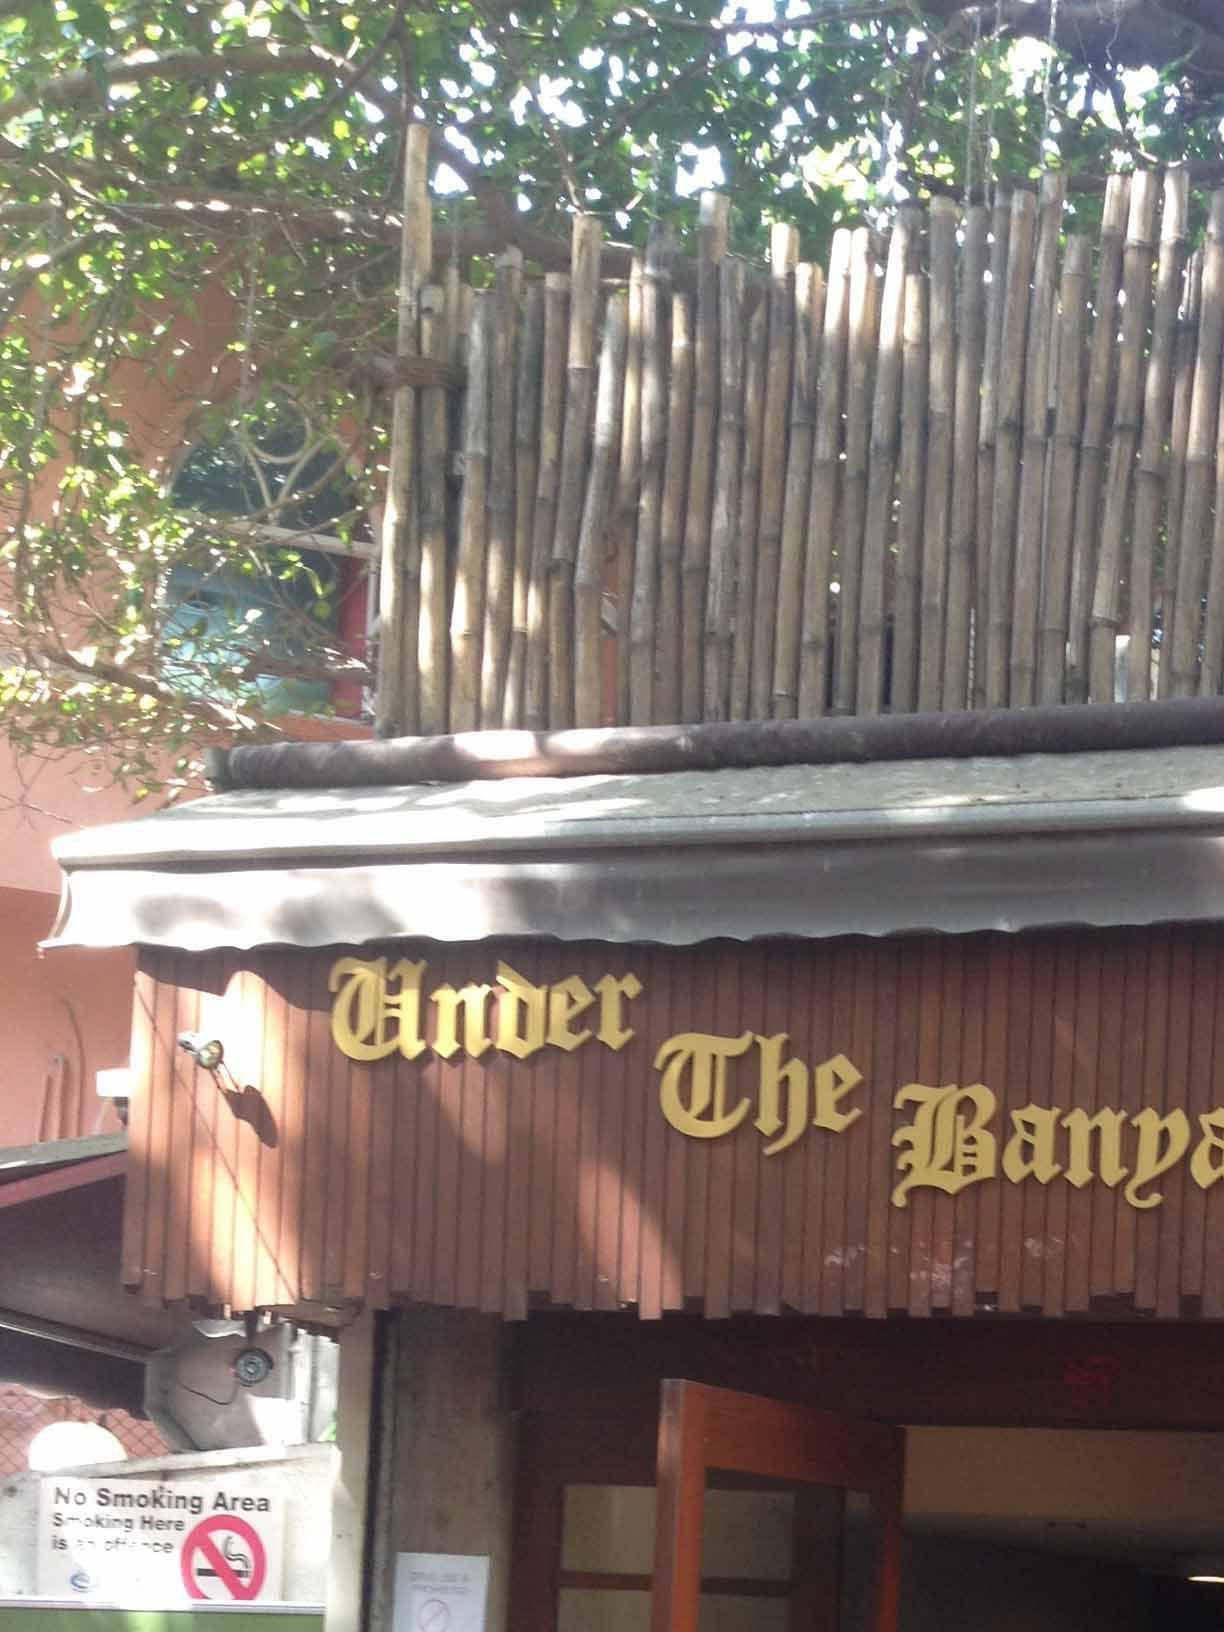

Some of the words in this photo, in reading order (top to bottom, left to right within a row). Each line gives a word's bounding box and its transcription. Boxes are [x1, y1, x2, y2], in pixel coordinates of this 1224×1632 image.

[328, 956, 644, 1062] Under
[653, 1030, 863, 1156] The
[54, 1487, 87, 1506] No
[96, 1487, 203, 1514] Smoking
[212, 1492, 271, 1513] Area
[140, 1515, 186, 1532] Here
[52, 1535, 68, 1551] is
